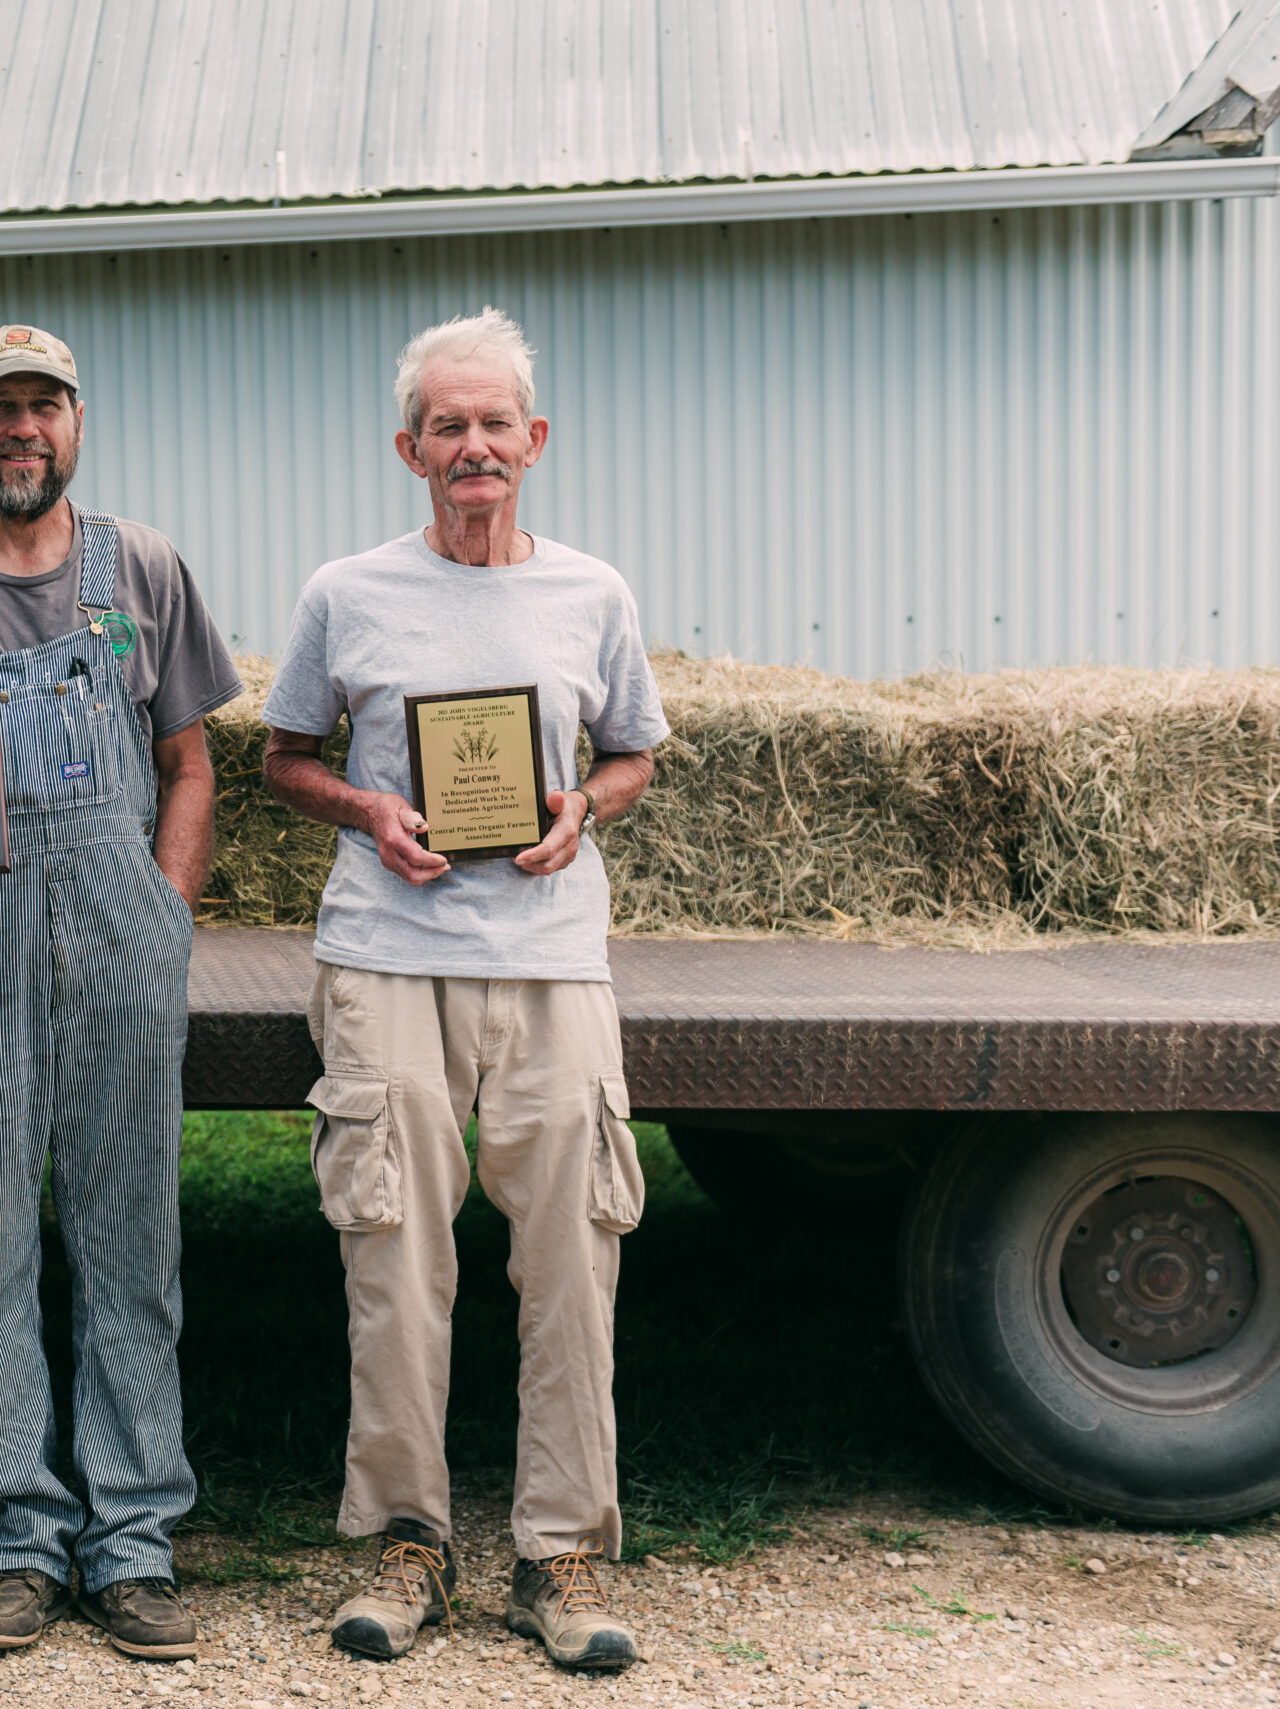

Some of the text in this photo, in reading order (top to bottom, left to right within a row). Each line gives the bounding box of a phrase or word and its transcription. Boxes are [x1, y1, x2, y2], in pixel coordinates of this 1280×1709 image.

[467, 704, 508, 713] VOGELSBERG
[430, 710, 515, 723] SUSTAINABLE AGRICULTURE
[453, 773, 501, 785] Paul Conway
[450, 789, 490, 797] Recognition
[445, 798, 478, 806] Dedicated
[441, 803, 520, 815] Sustainable Agriculture
[429, 826, 455, 835] Central
[457, 825, 477, 833] Plains
[478, 823, 505, 831] Organic
[464, 832, 502, 841] Association
